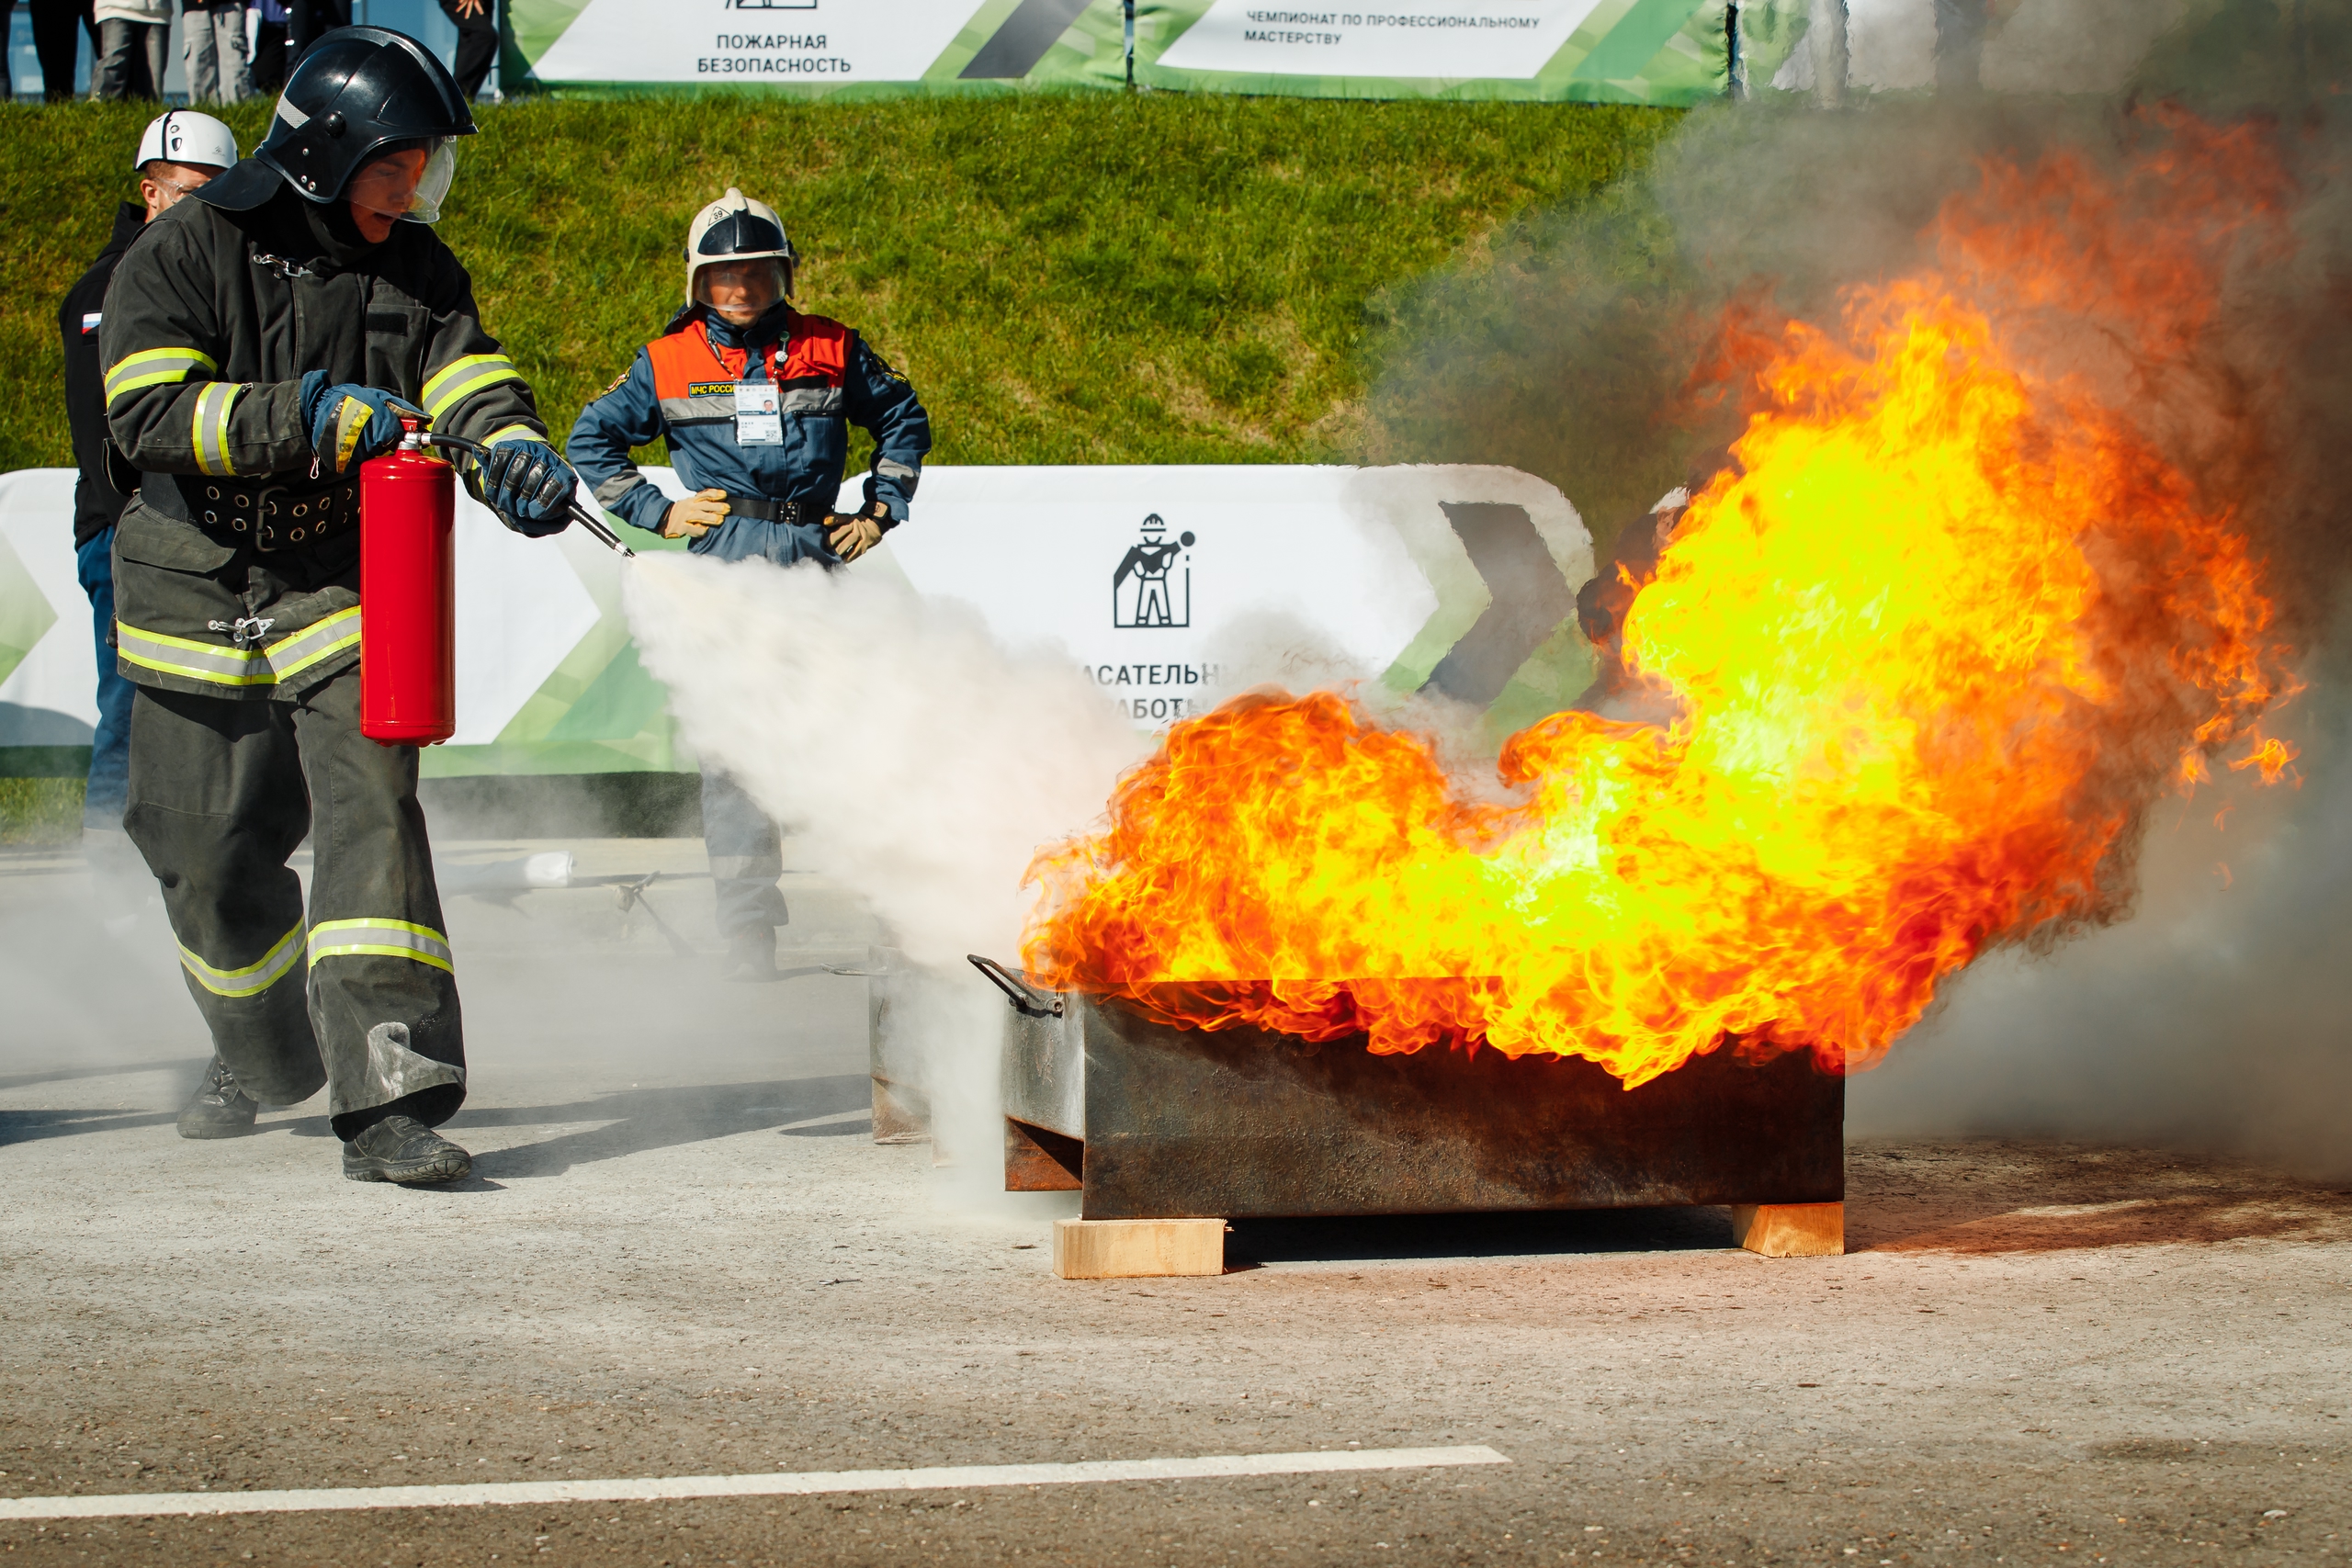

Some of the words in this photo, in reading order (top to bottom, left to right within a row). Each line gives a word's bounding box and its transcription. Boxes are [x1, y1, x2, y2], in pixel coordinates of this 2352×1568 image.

[1247, 11, 1338, 25] ЧЕМПИОНАТ
[1341, 14, 1363, 26] ПО
[1366, 14, 1540, 28] ПРОФЕССИОНАЛЬНОМУ
[717, 34, 828, 49] ПОЖАРНАЯ
[1244, 30, 1342, 44] МАСТЕРСТВУ
[697, 58, 852, 73] БЕЗОПАСНОСТЬ
[691, 386, 707, 395] МЧС
[708, 384, 736, 393] РОССИ
[1080, 662, 1222, 685] АСАТЕЛЬН
